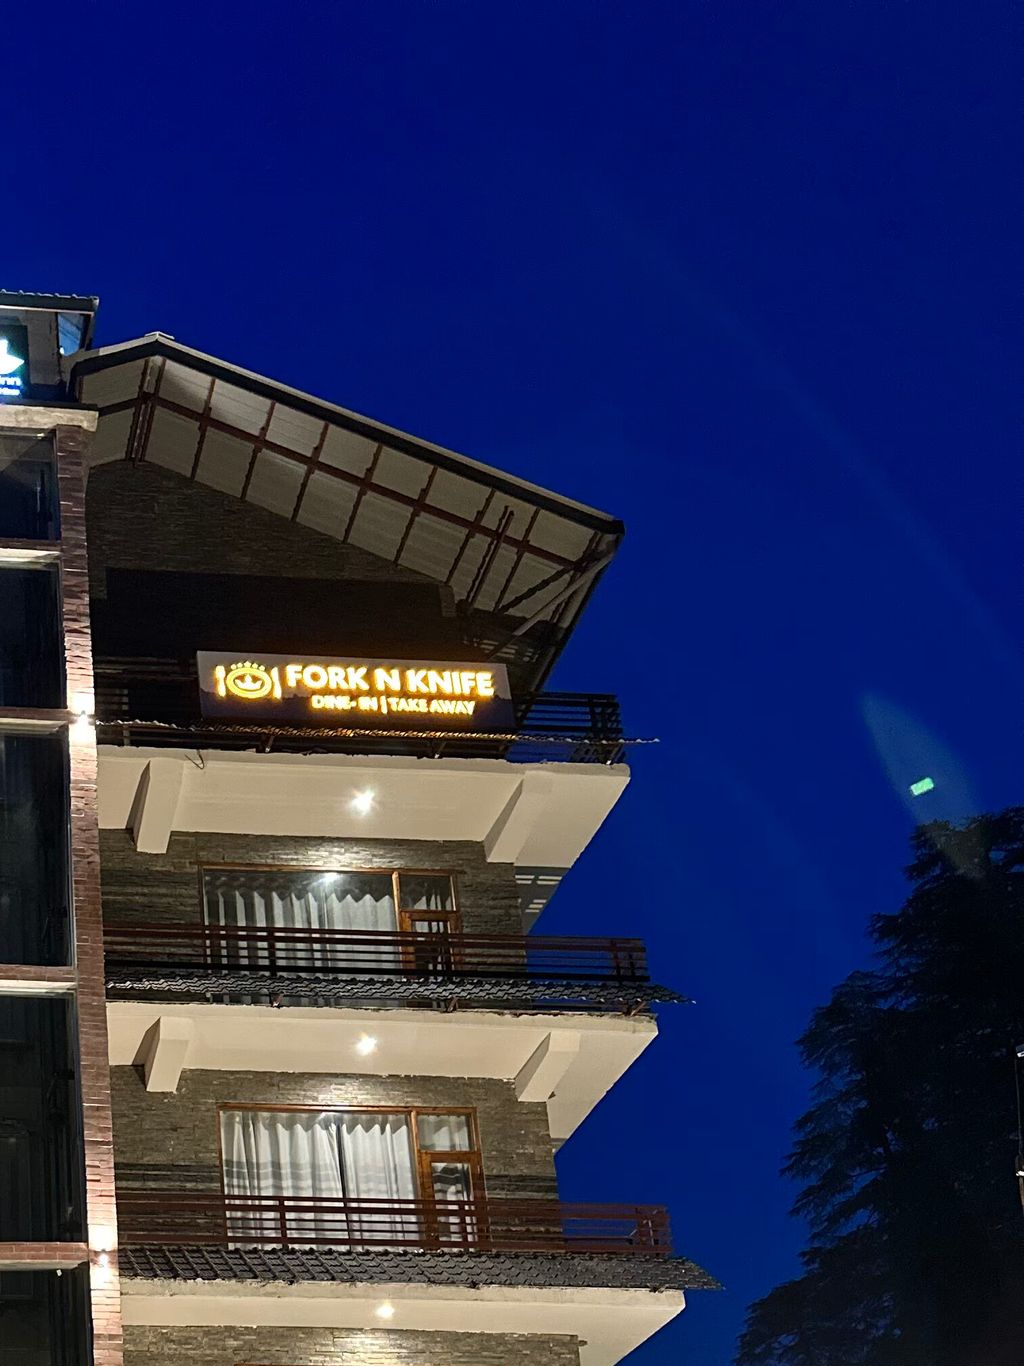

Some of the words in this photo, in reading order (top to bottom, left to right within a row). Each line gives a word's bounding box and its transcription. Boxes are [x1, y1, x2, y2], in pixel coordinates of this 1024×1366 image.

[285, 663, 370, 691] FORK
[374, 667, 401, 692] N
[407, 669, 495, 697] KNIFE
[358, 696, 378, 711] IN
[387, 697, 428, 713] TAKE
[429, 699, 476, 715] AWAY
